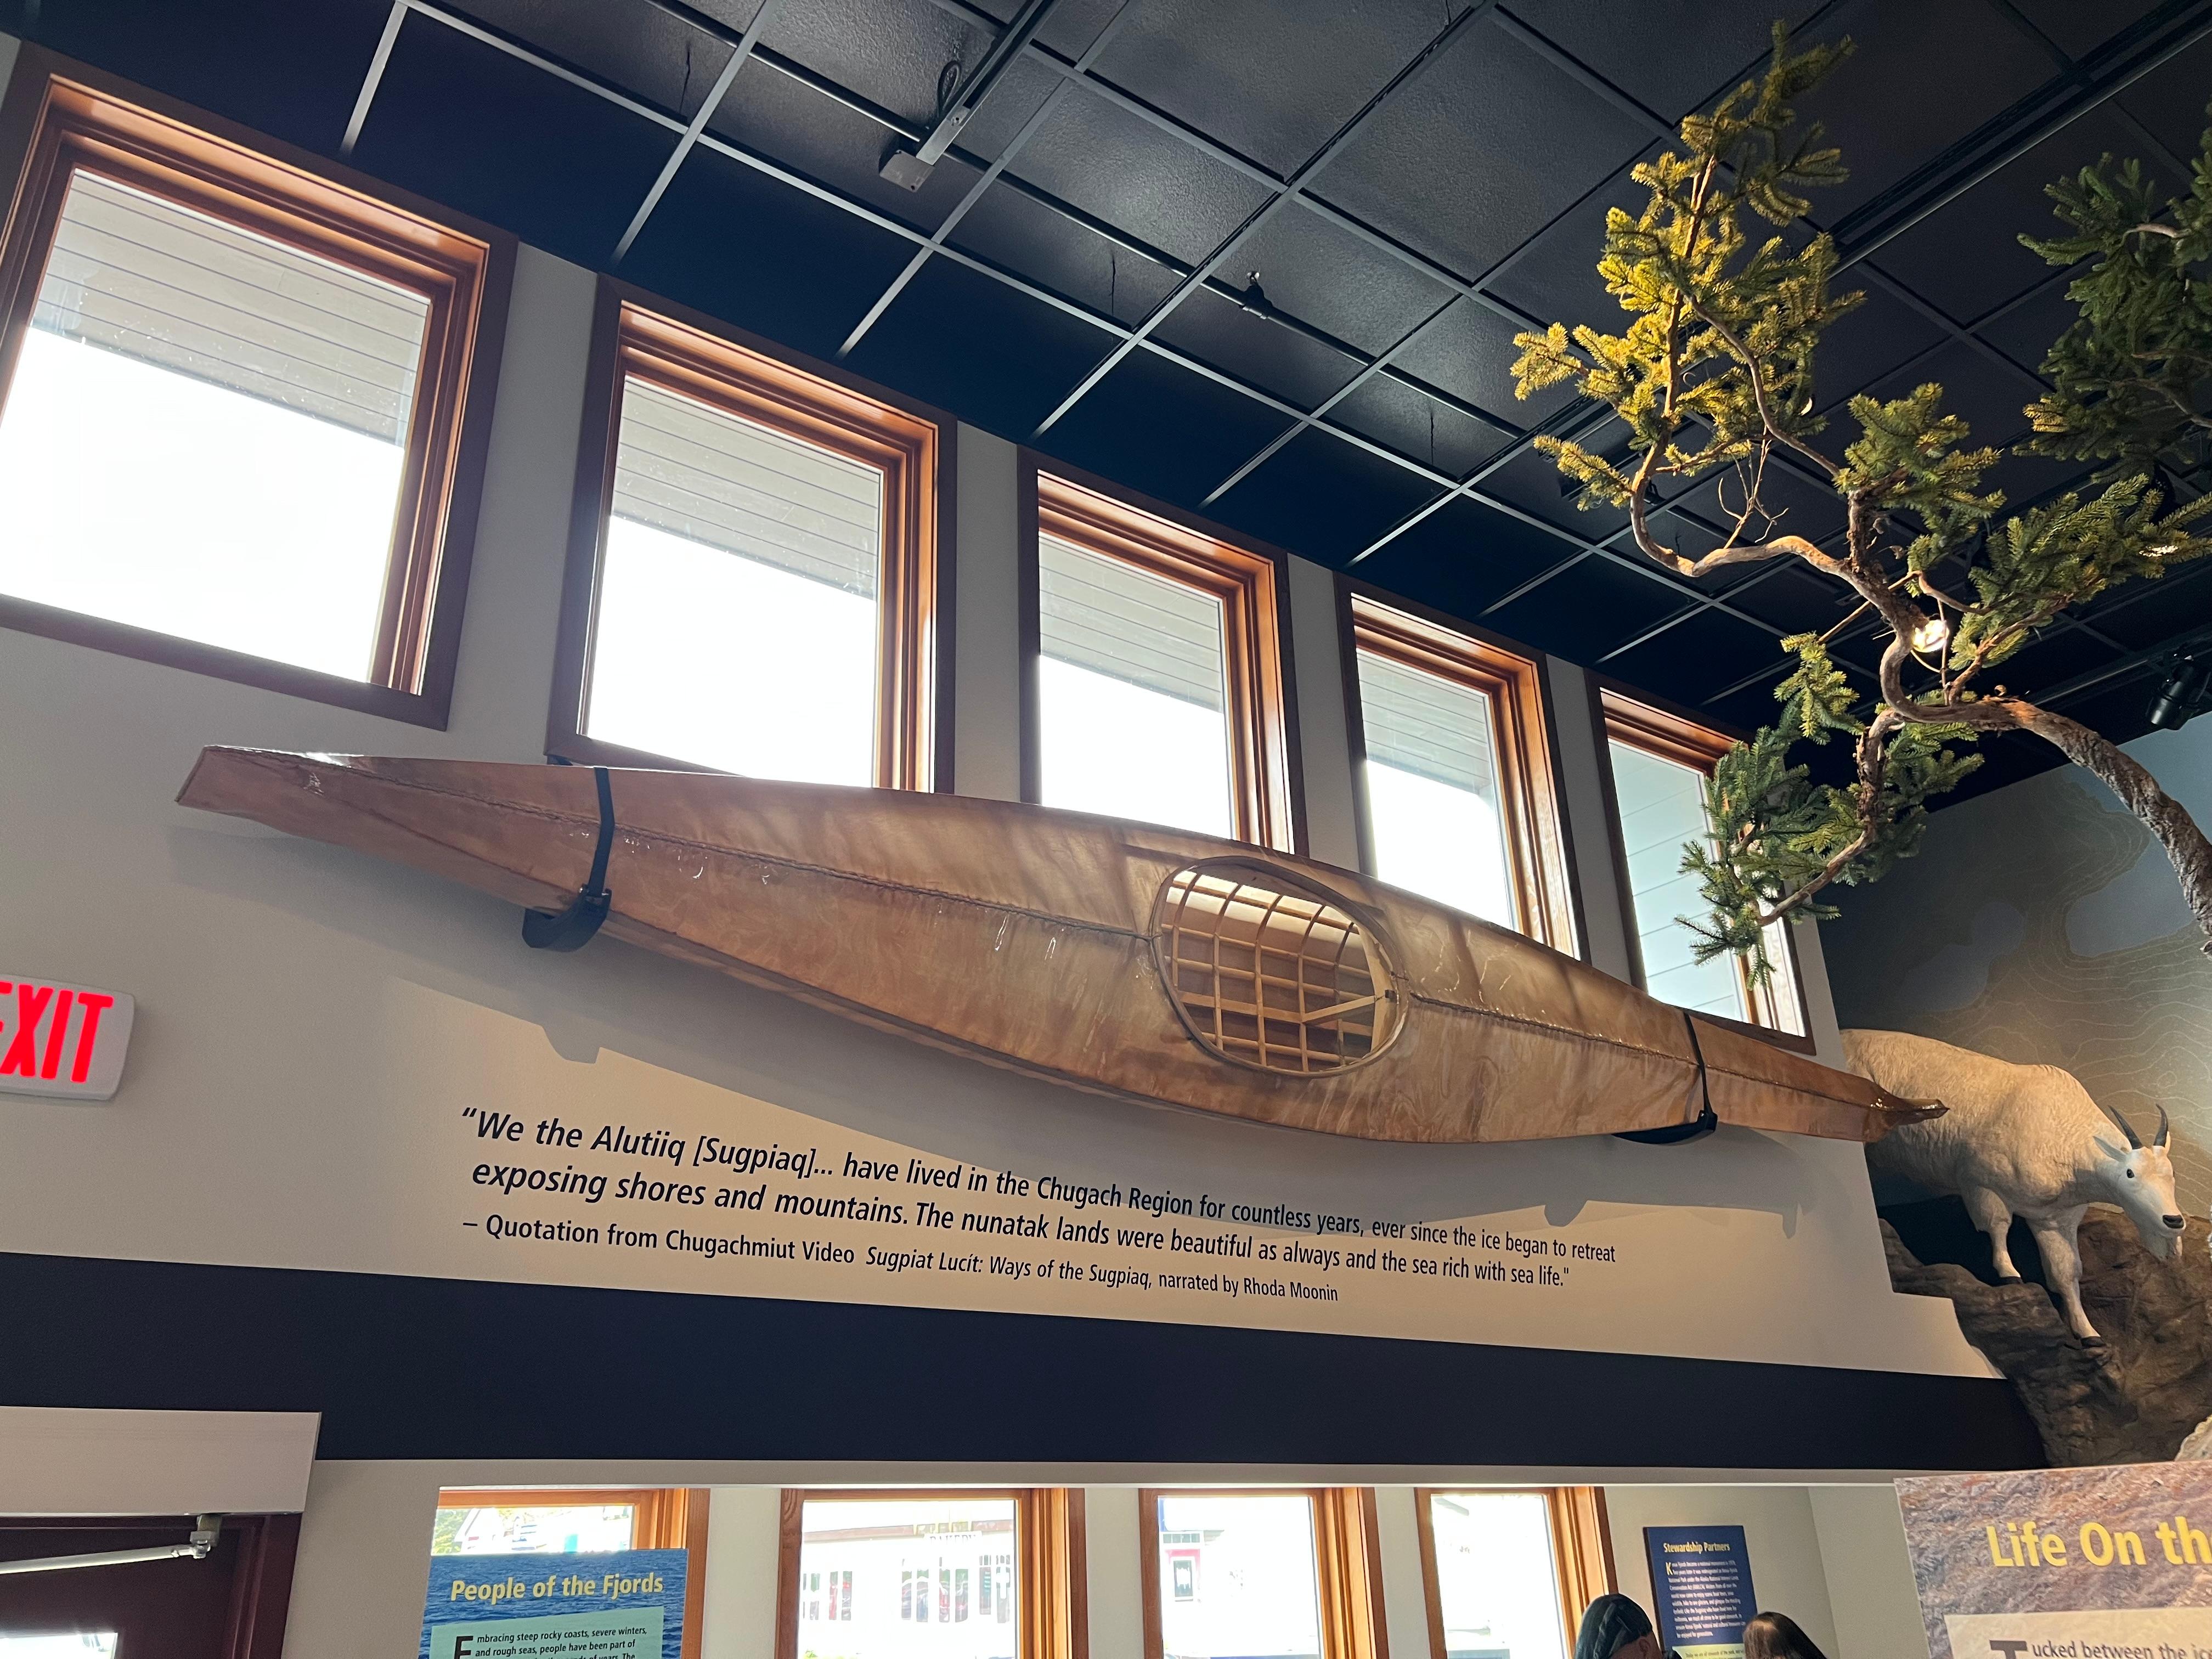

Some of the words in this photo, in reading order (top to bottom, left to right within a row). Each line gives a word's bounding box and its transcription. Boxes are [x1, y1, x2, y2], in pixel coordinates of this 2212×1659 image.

[537, 1118, 582, 1148] the
[590, 1126, 685, 1166] Alutiiq
[843, 1152, 898, 1181] have
[906, 1159, 962, 1188] lived
[968, 1167, 987, 1192] in
[997, 1171, 1029, 1196] the
[1038, 1177, 1121, 1209] Chugach
[1128, 1188, 1192, 1217] Region
[1200, 1195, 1225, 1218] for
[1232, 1204, 1311, 1228] countless
[1317, 1215, 1363, 1237] years,
[1373, 1222, 1406, 1238] ever
[1411, 1221, 1447, 1244] since
[1453, 1226, 1476, 1246] the
[1482, 1229, 1500, 1249] ice
[1506, 1231, 1547, 1258] began
[1553, 1239, 1566, 1256] to
[1572, 1243, 1615, 1262] retreat
[473, 1164, 607, 1203] exposing
[615, 1172, 706, 1205] shores
[715, 1184, 766, 1210] and
[775, 1194, 907, 1224] mountains.
[917, 1202, 953, 1228] The
[962, 1214, 1049, 1238] nunatak
[1057, 1216, 1109, 1244] lands
[1118, 1229, 1164, 1249] were
[1171, 1228, 1252, 1257] beautiful
[1259, 1244, 1277, 1260] as
[1283, 1241, 1340, 1271] always
[1346, 1249, 1376, 1269] and
[1382, 1250, 1406, 1272] the
[1413, 1259, 1437, 1275] sea
[1443, 1256, 1469, 1278] rich
[1475, 1261, 1505, 1281] with
[1511, 1268, 1533, 1283] sea
[1539, 1265, 1568, 1286] life."
[487, 1215, 598, 1243] Quotation
[607, 1223, 657, 1248] from
[666, 1229, 795, 1259] Chugachmiut
[802, 1241, 854, 1263] Video
[866, 1246, 934, 1272] Sugpiat
[939, 1252, 983, 1272] Lucít:
[991, 1256, 1031, 1280] Ways
[1037, 1260, 1055, 1278] of
[1059, 1261, 1083, 1280] the
[1089, 1265, 1152, 1290] Sugpiaq,
[1159, 1274, 1218, 1291] narrated
[1223, 1275, 1238, 1297] by
[1244, 1277, 1285, 1296] Rhoda
[1290, 1282, 1338, 1301] Moonin
[1663, 1542, 1703, 1554] Stewardship
[1703, 1542, 1730, 1552] Partners
[1986, 1521, 2068, 1567] Life
[2080, 1522, 2147, 1566] On
[2155, 1516, 2212, 1565] th
[451, 1577, 526, 1605] People
[533, 1575, 557, 1598] of
[562, 1575, 596, 1596] the
[603, 1572, 664, 1600] Fjords
[476, 1647, 491, 1657] and
[493, 1646, 516, 1657] rough
[539, 1644, 566, 1655] people
[569, 1643, 587, 1651] have
[589, 1642, 607, 1650] been
[610, 1641, 625, 1651] part
[628, 1639, 635, 1647] of
[517, 1633, 538, 1642] steep
[541, 1630, 562, 1641] rocky
[564, 1629, 589, 1638] coasts,
[618, 1627, 647, 1635] winters,
[2080, 1640, 2154, 1659] between
[2159, 1641, 2187, 1659] the
